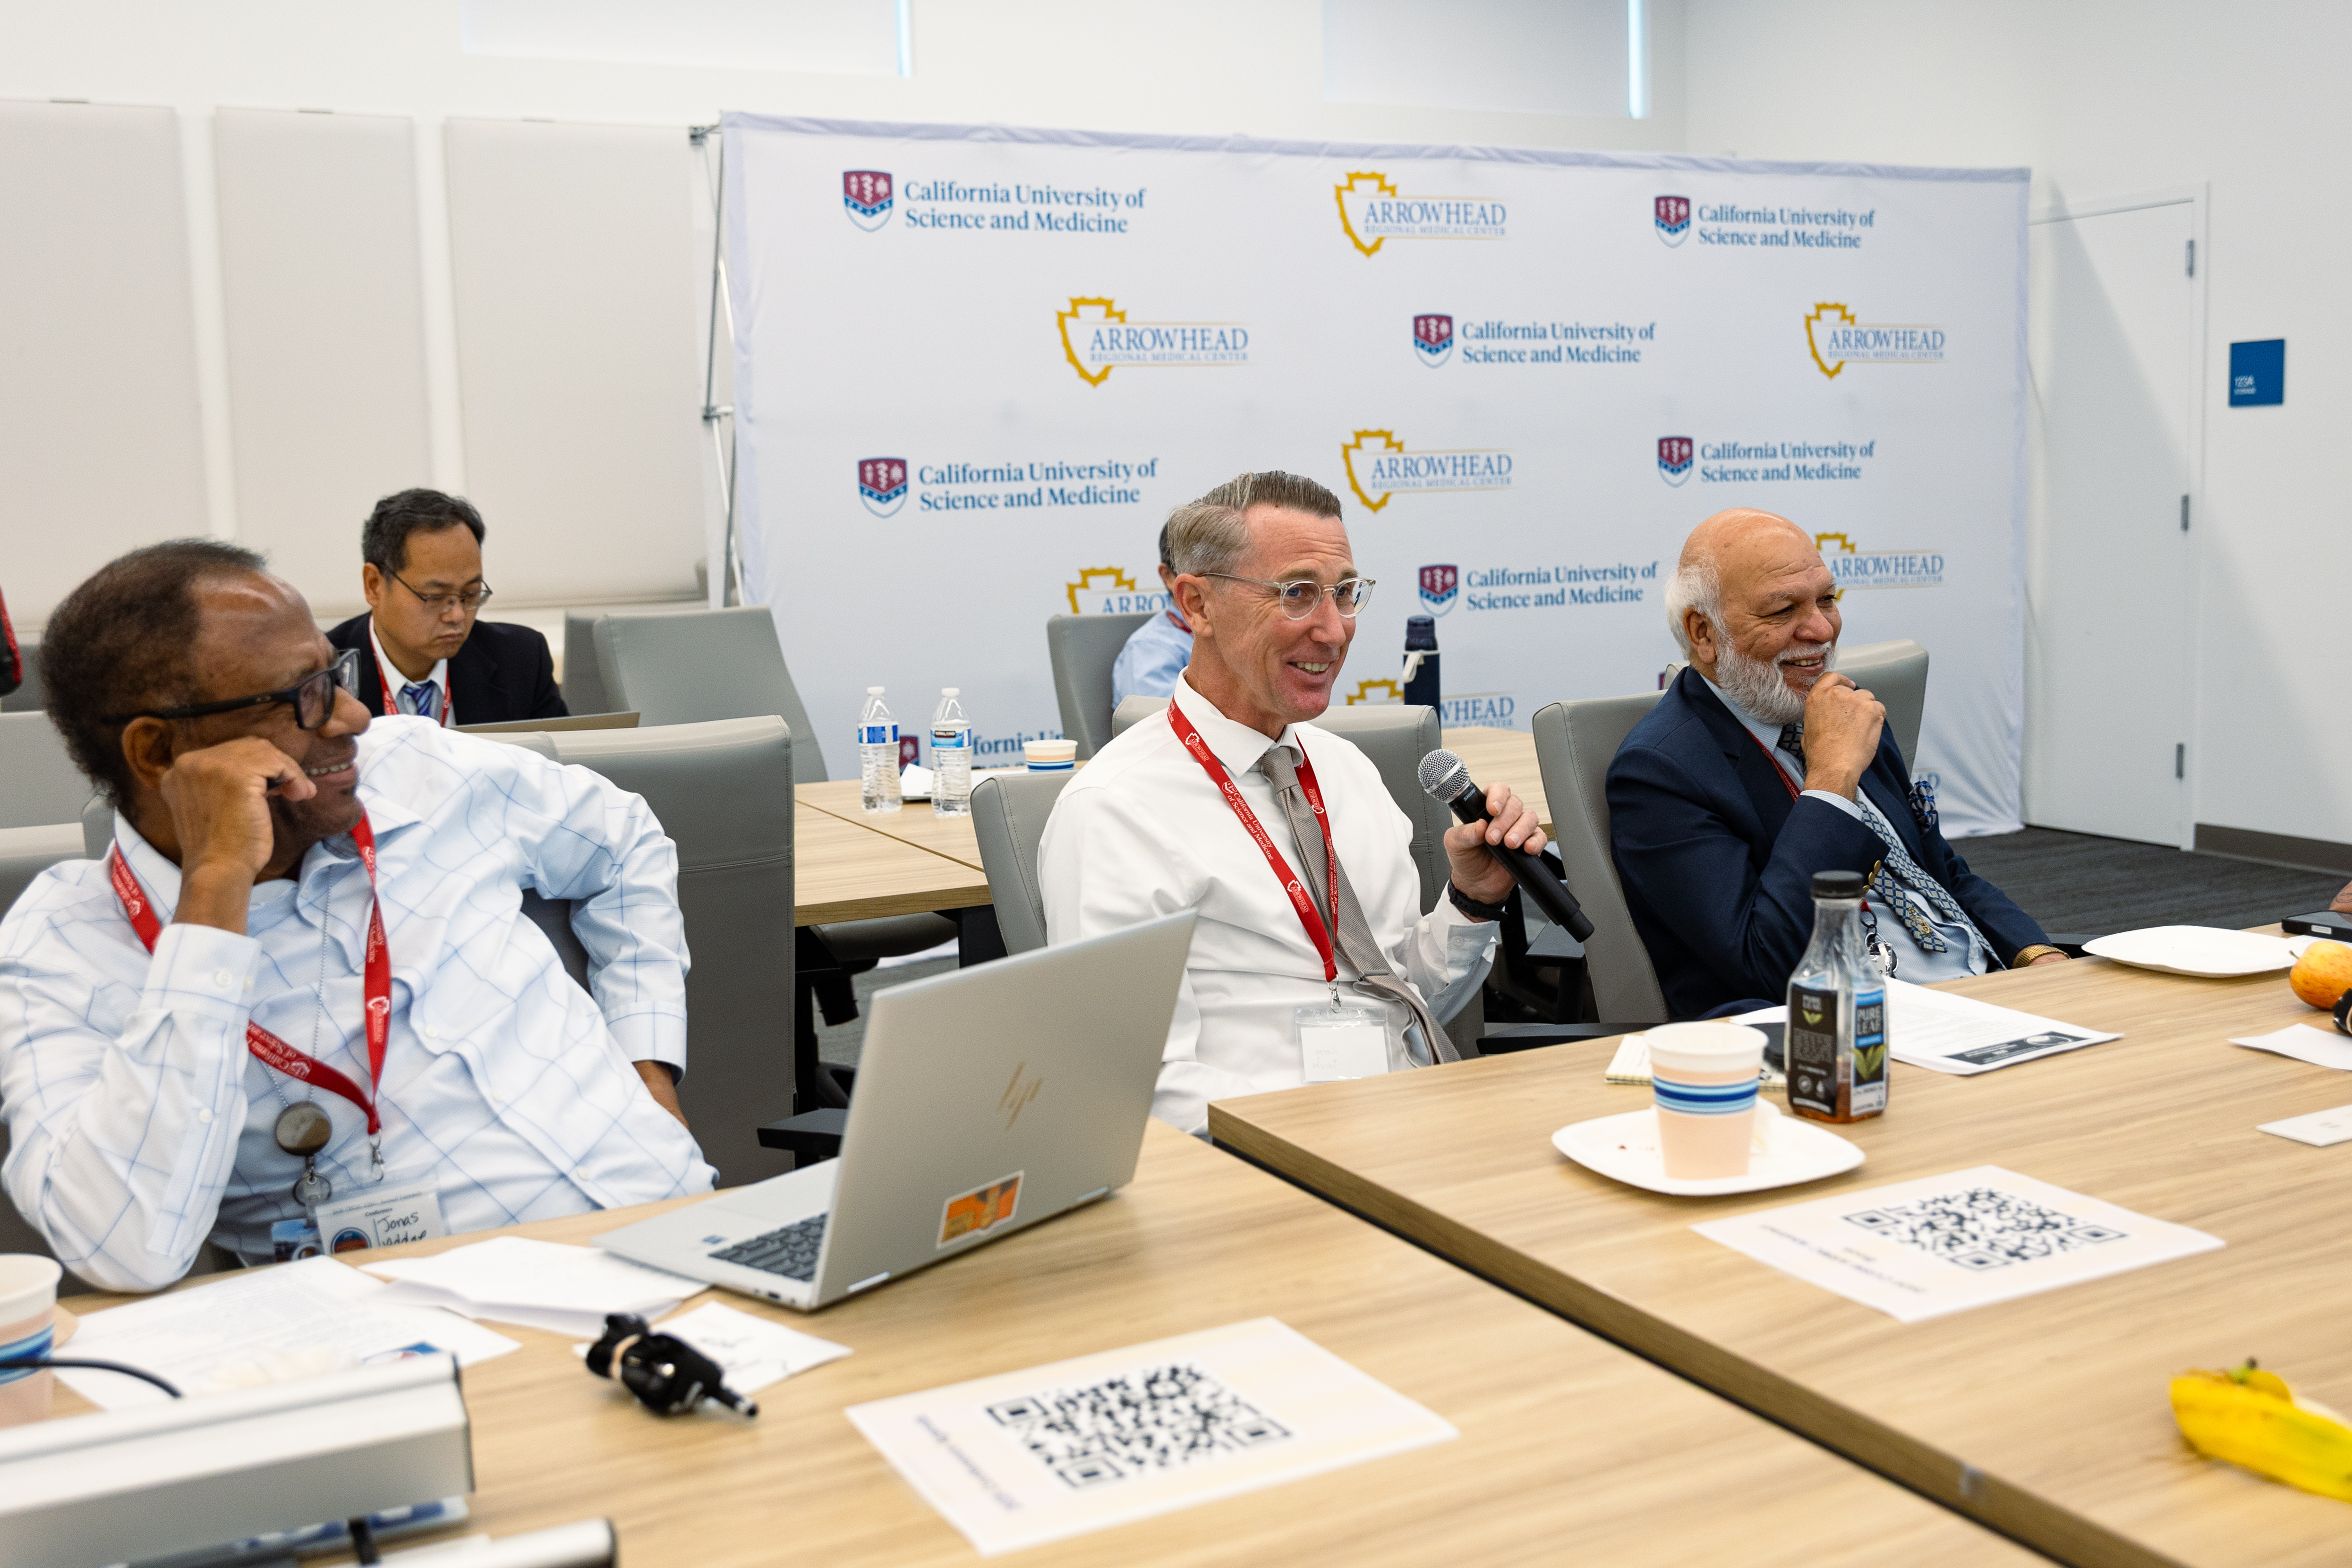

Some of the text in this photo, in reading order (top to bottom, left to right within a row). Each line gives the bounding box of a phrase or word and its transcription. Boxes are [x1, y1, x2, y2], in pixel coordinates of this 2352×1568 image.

[903, 180, 1145, 208] California University of
[905, 208, 1128, 233] Science and Medicine
[1364, 201, 1507, 225] ARROWHEAD
[1698, 205, 1875, 228] California University of
[1699, 230, 1860, 248] Science and Medicine
[1090, 327, 1249, 351] ARROWHEAD
[1461, 322, 1655, 342] California University of
[1829, 329, 1945, 350] ARROWHEAD
[1462, 345, 1641, 363] Science and Medicine
[1701, 441, 1875, 462] California University of
[919, 457, 1158, 485] California University of
[1372, 454, 1512, 479] ARROWHEAD
[1701, 463, 1861, 482] Science and Medicine
[920, 485, 1141, 511] Science and Medicine
[1466, 562, 1658, 588] California University of
[1830, 554, 1944, 578] ARROWHEAD
[1466, 586, 1643, 611] Science and Medicine
[1190, 738, 1209, 761] ARROWHEAD
[1463, 787, 1476, 801] SHURE
[1232, 801, 1248, 823] Science
[1246, 823, 1257, 834] and
[1254, 833, 1273, 861] Medicine
[1234, 793, 1273, 848] California University
[1291, 886, 1309, 912] ARROWHEAD
[377, 1211, 419, 1232] Jonas
